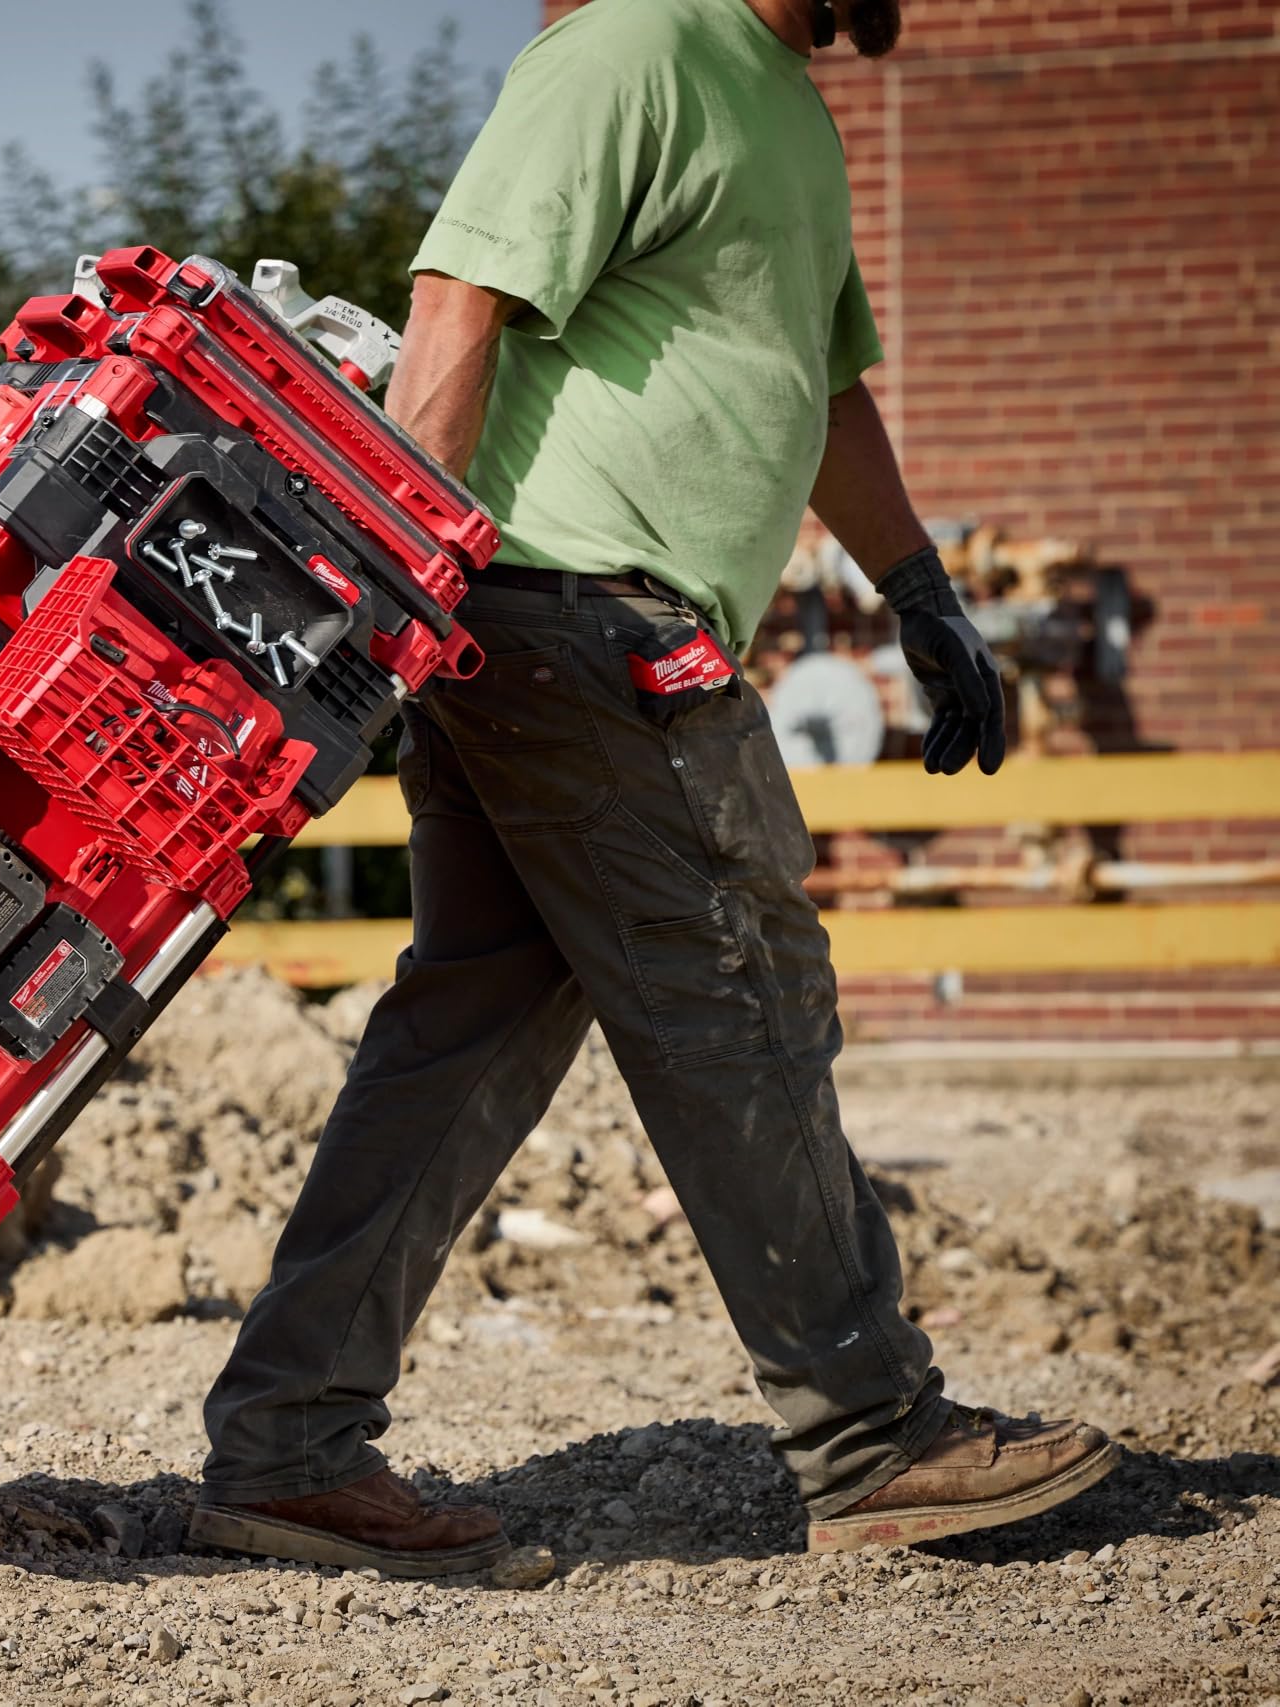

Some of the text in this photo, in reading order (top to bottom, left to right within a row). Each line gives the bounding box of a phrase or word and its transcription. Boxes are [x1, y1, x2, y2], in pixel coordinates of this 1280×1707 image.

[652, 645, 707, 681] Milwaukee
[665, 675, 705, 693] WIDE BLADE
